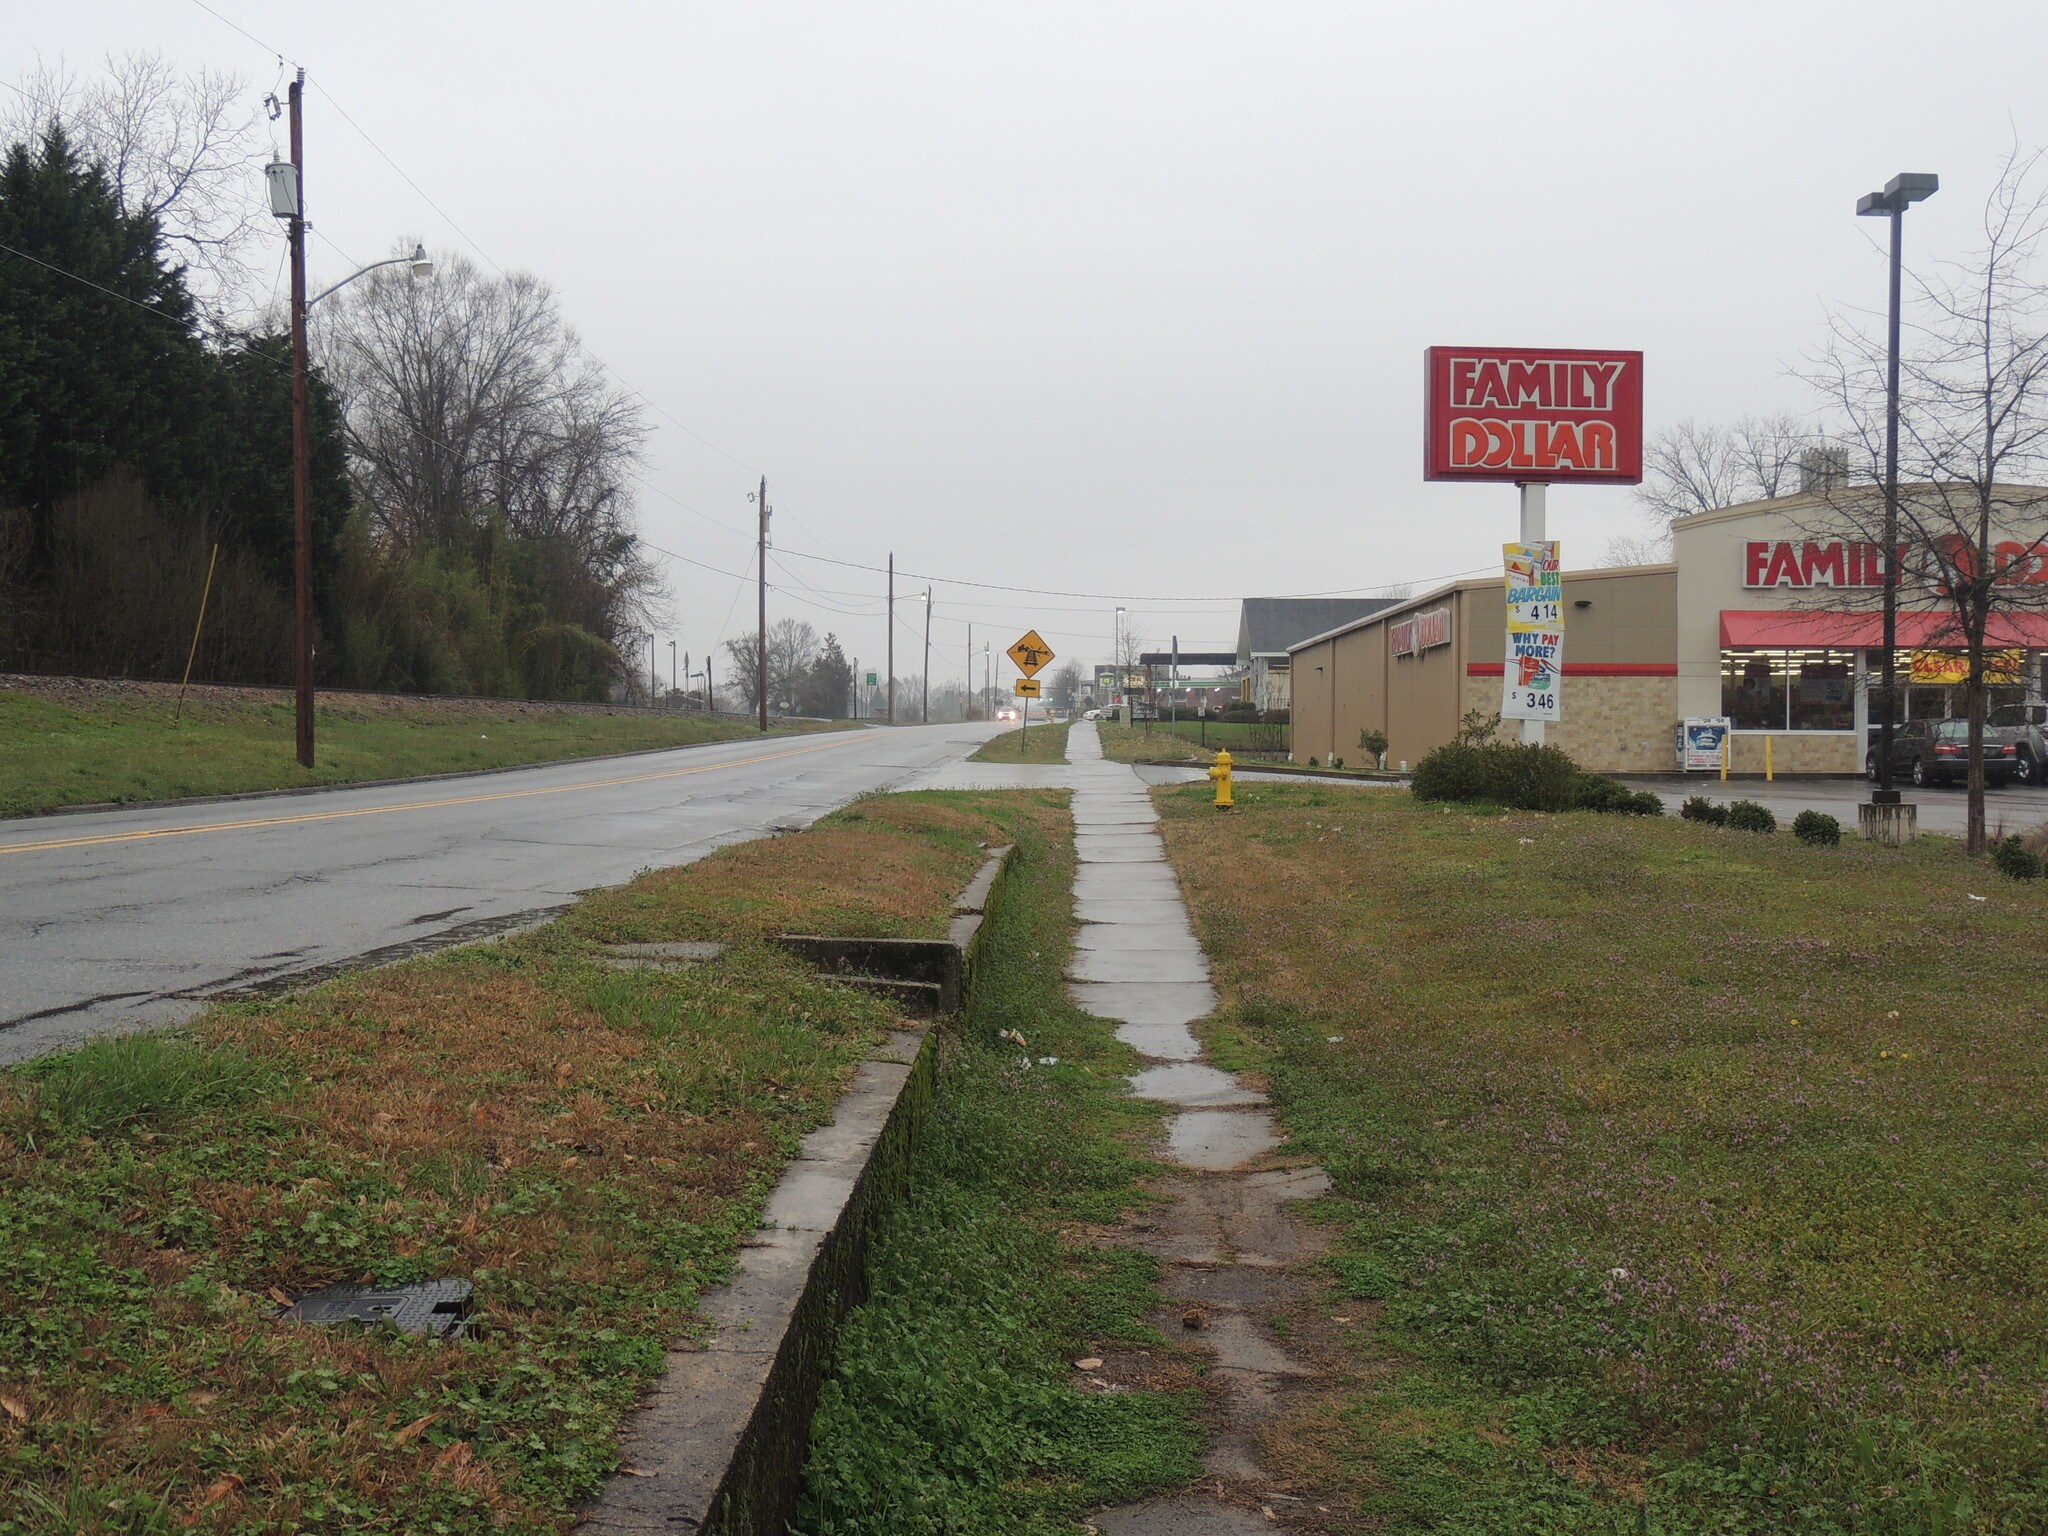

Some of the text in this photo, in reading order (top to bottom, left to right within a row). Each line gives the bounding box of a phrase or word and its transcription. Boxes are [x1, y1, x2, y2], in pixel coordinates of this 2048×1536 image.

[1450, 358, 1626, 410] FAMILY
[1450, 418, 1618, 470] DOLLAR
[1542, 559, 1560, 571] OUR
[1540, 571, 1560, 586] BEST
[1507, 586, 1562, 604] BARGAIN
[1512, 632, 1560, 646] WHY PAY
[1515, 645, 1556, 658] MORE?
